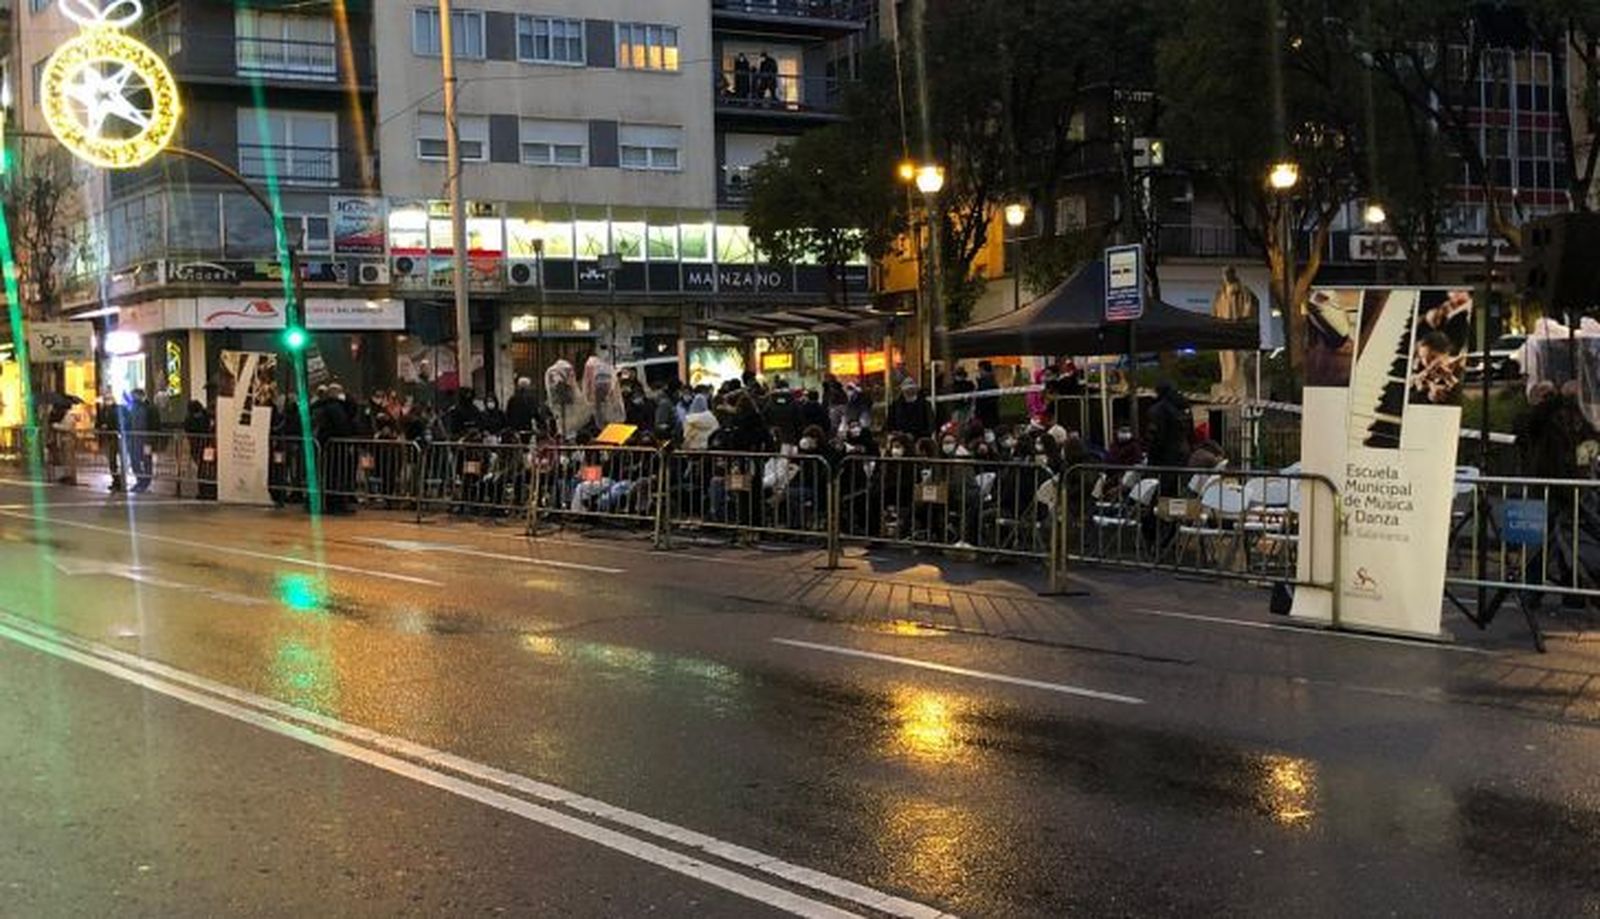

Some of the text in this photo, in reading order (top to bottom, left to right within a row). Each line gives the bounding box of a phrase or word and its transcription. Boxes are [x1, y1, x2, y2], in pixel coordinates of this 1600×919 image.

[688, 271, 781, 287] MANZANO
[1346, 463, 1399, 479] Escuela
[1345, 479, 1412, 496] Municipal
[1344, 494, 1361, 507] de
[1355, 509, 1399, 527] Danza
